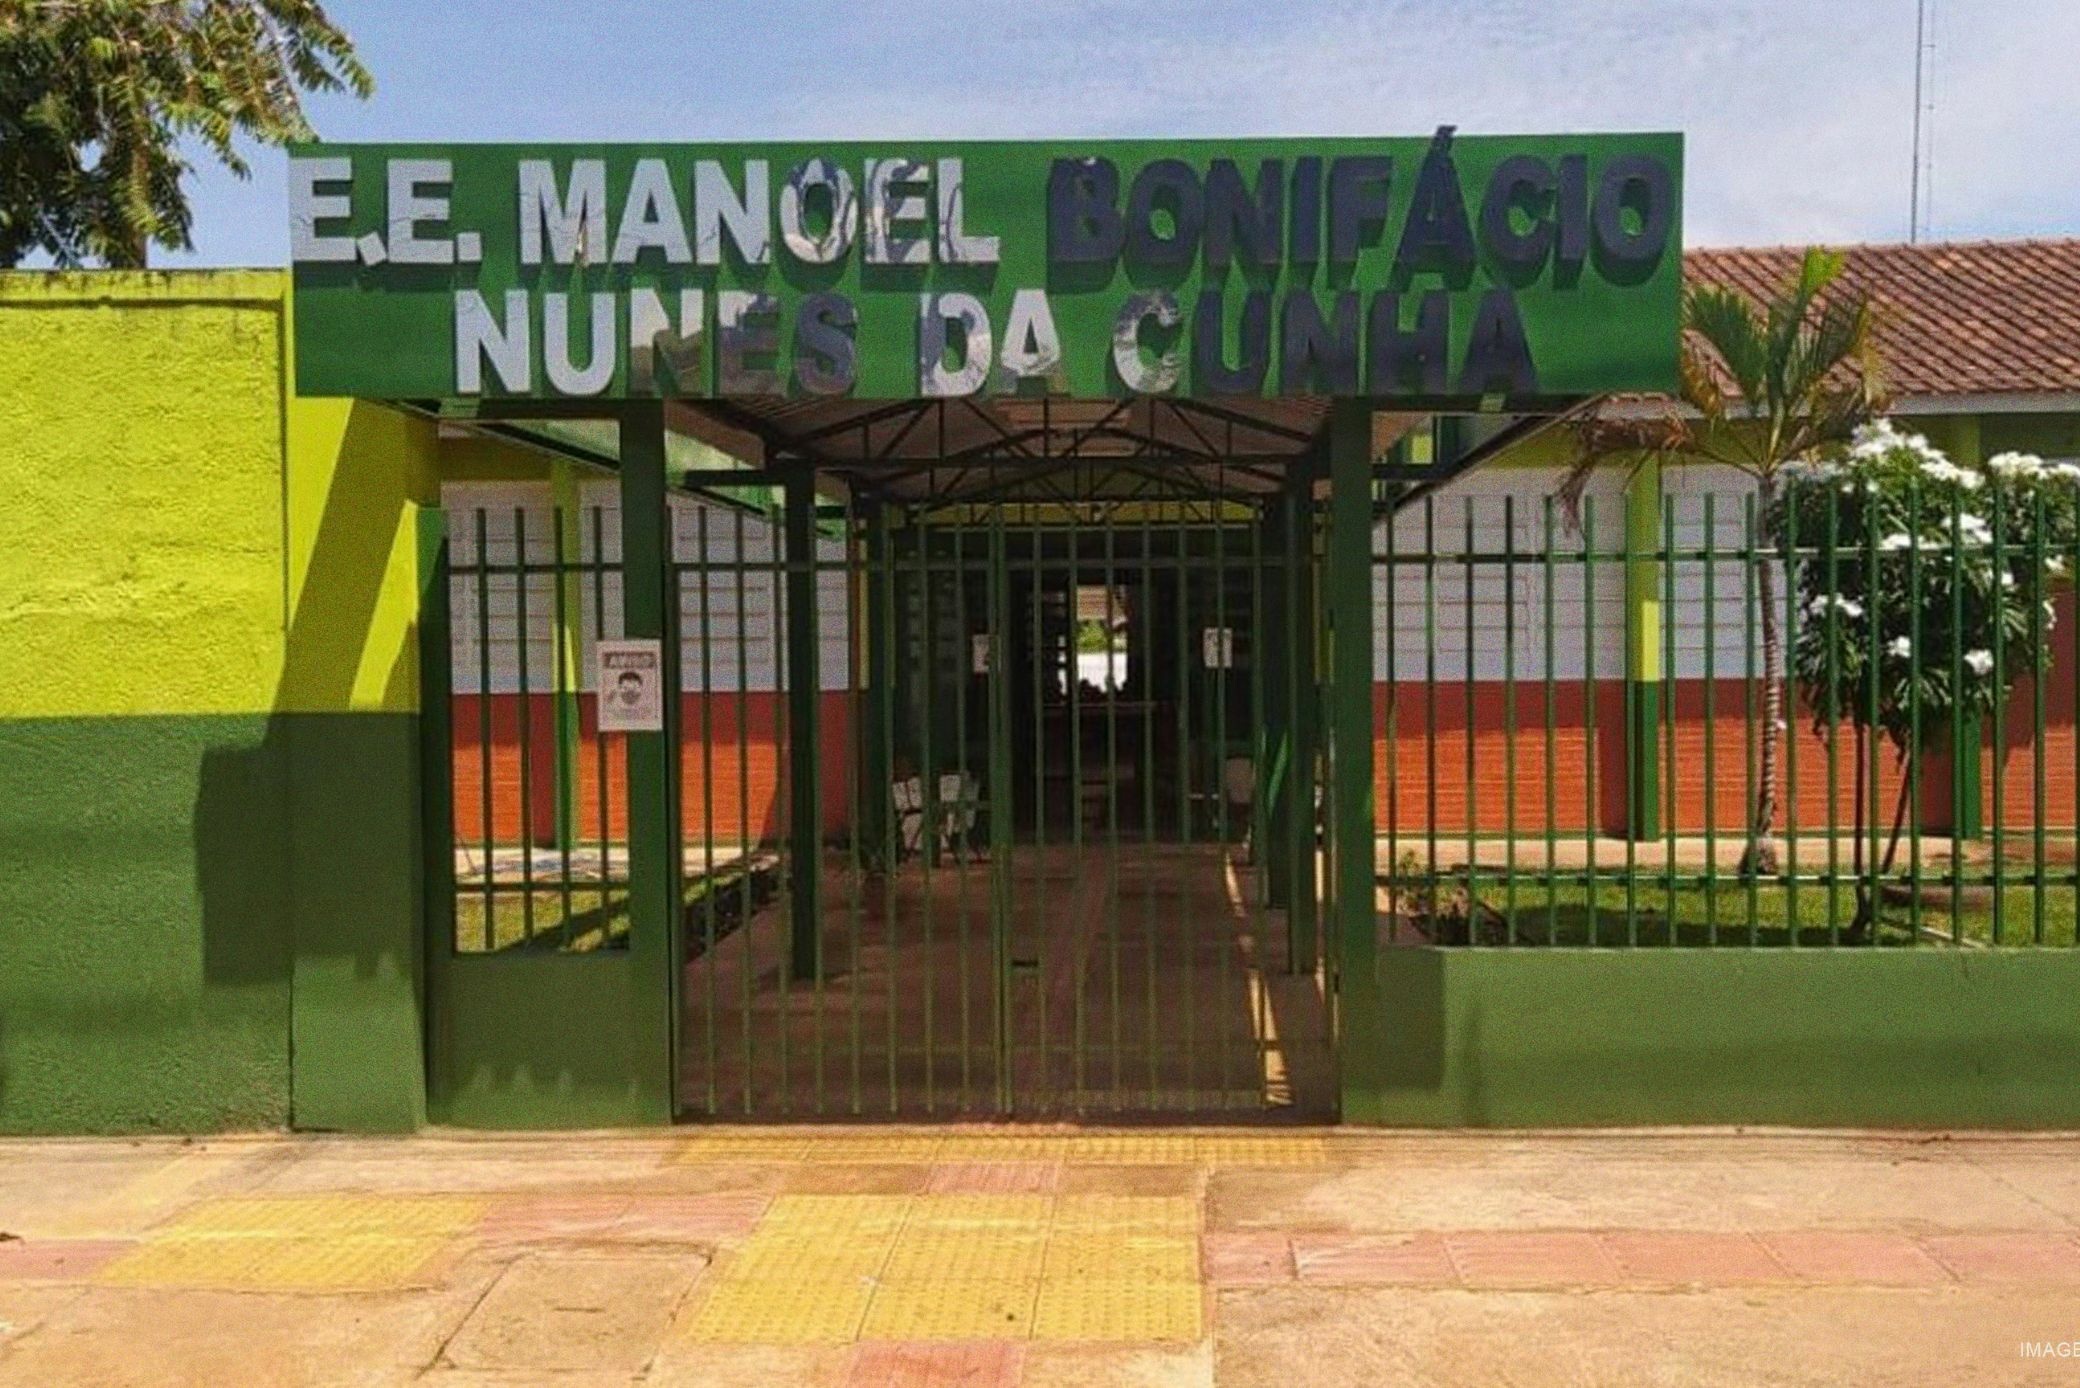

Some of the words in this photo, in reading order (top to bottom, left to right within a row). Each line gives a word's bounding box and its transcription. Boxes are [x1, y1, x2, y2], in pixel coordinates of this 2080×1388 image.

[289, 156, 482, 267] E.E.
[519, 157, 1000, 266] MANOEL
[1047, 126, 1674, 270] BONIFÁCIO
[455, 288, 858, 396] NUNES
[920, 289, 1064, 397] DA
[1112, 288, 1539, 396] CUNHA
